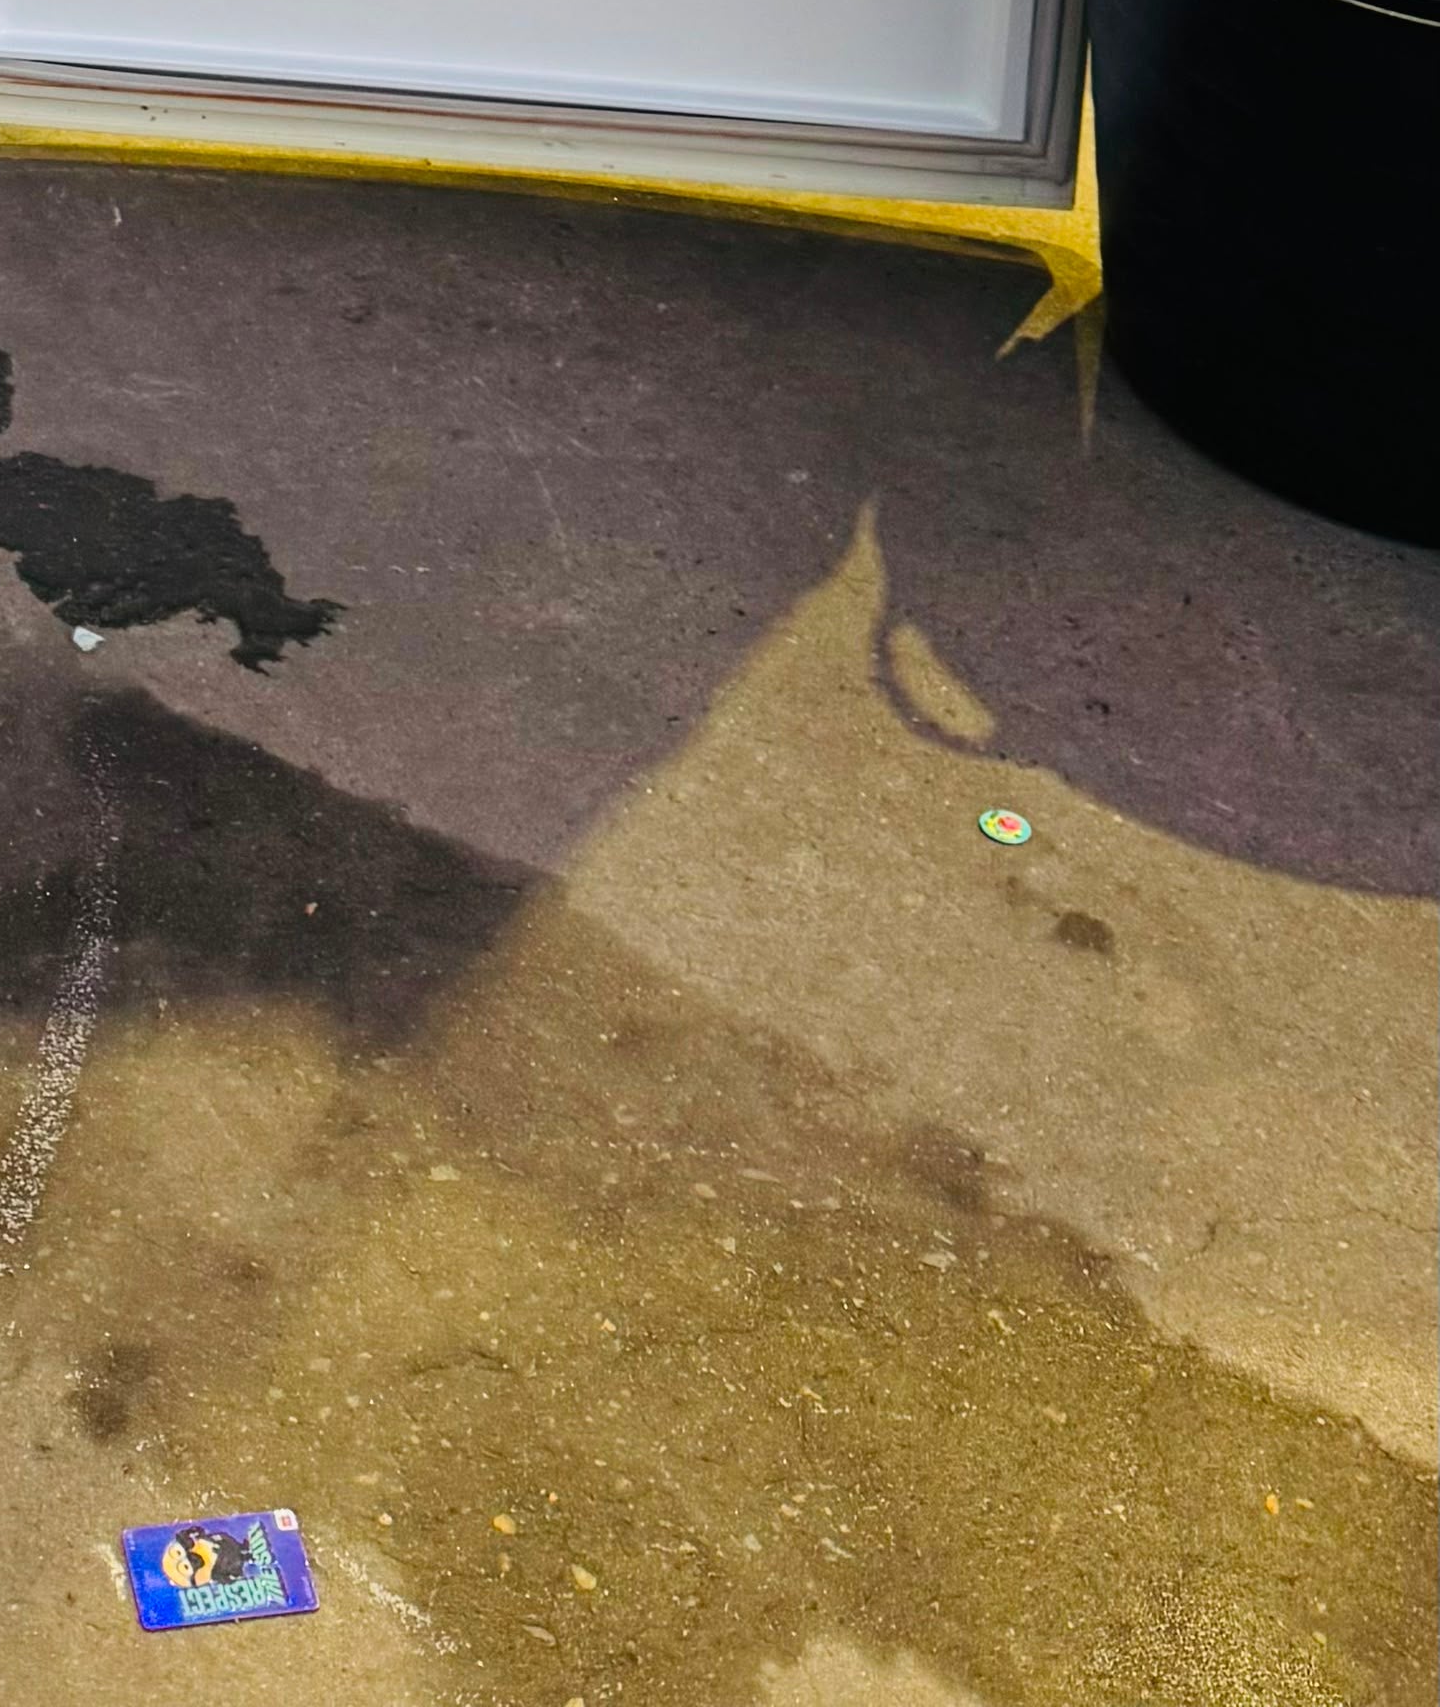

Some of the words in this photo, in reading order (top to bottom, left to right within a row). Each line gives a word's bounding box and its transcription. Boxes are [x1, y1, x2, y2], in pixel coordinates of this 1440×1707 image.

[247, 1520, 273, 1567] SUIT
[178, 1578, 266, 1618] RESPECT
[260, 1566, 289, 1607] THE
